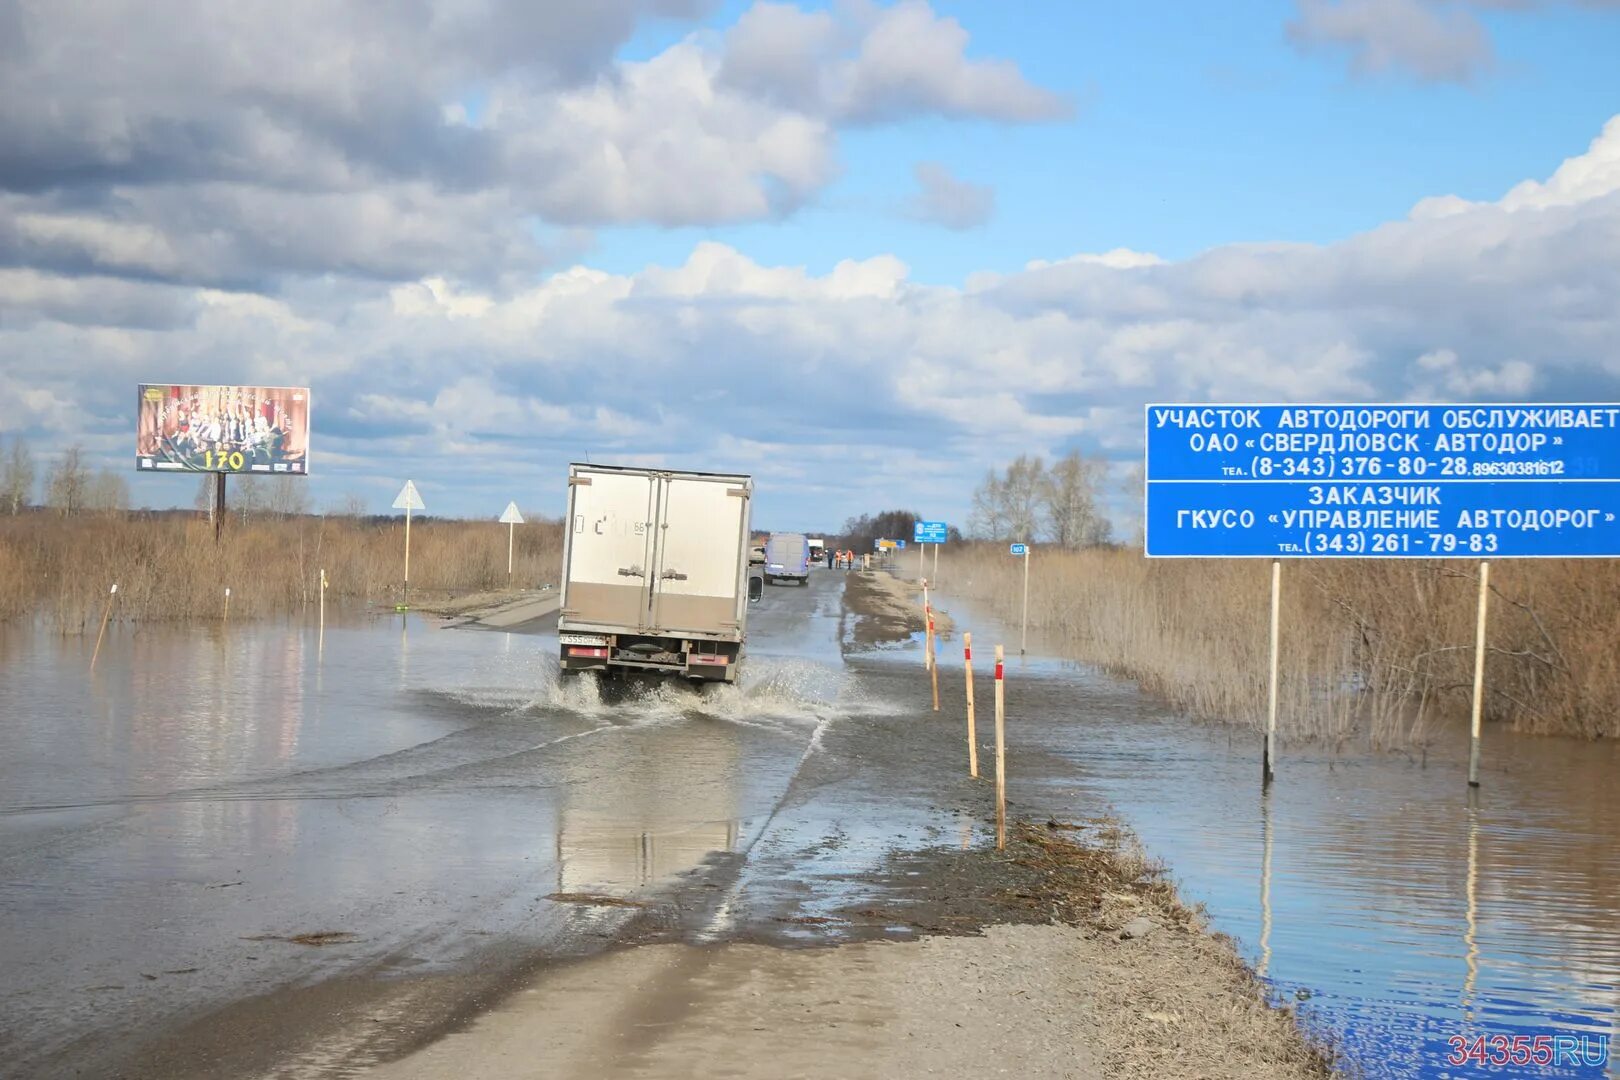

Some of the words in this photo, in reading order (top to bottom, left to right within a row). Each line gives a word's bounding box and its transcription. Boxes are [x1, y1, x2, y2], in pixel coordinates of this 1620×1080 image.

[1155, 409, 1262, 429] УЧАСТОК
[1278, 409, 1430, 431] АВТОДОРОГИ
[1442, 409, 1619, 429] ОБСЛУЖИВАЕТ
[1190, 433, 1238, 452] ОАО
[204, 450, 244, 470] 170
[1308, 486, 1442, 505] ЗАКАЗЧИК
[1177, 510, 1255, 529] ГКУСО
